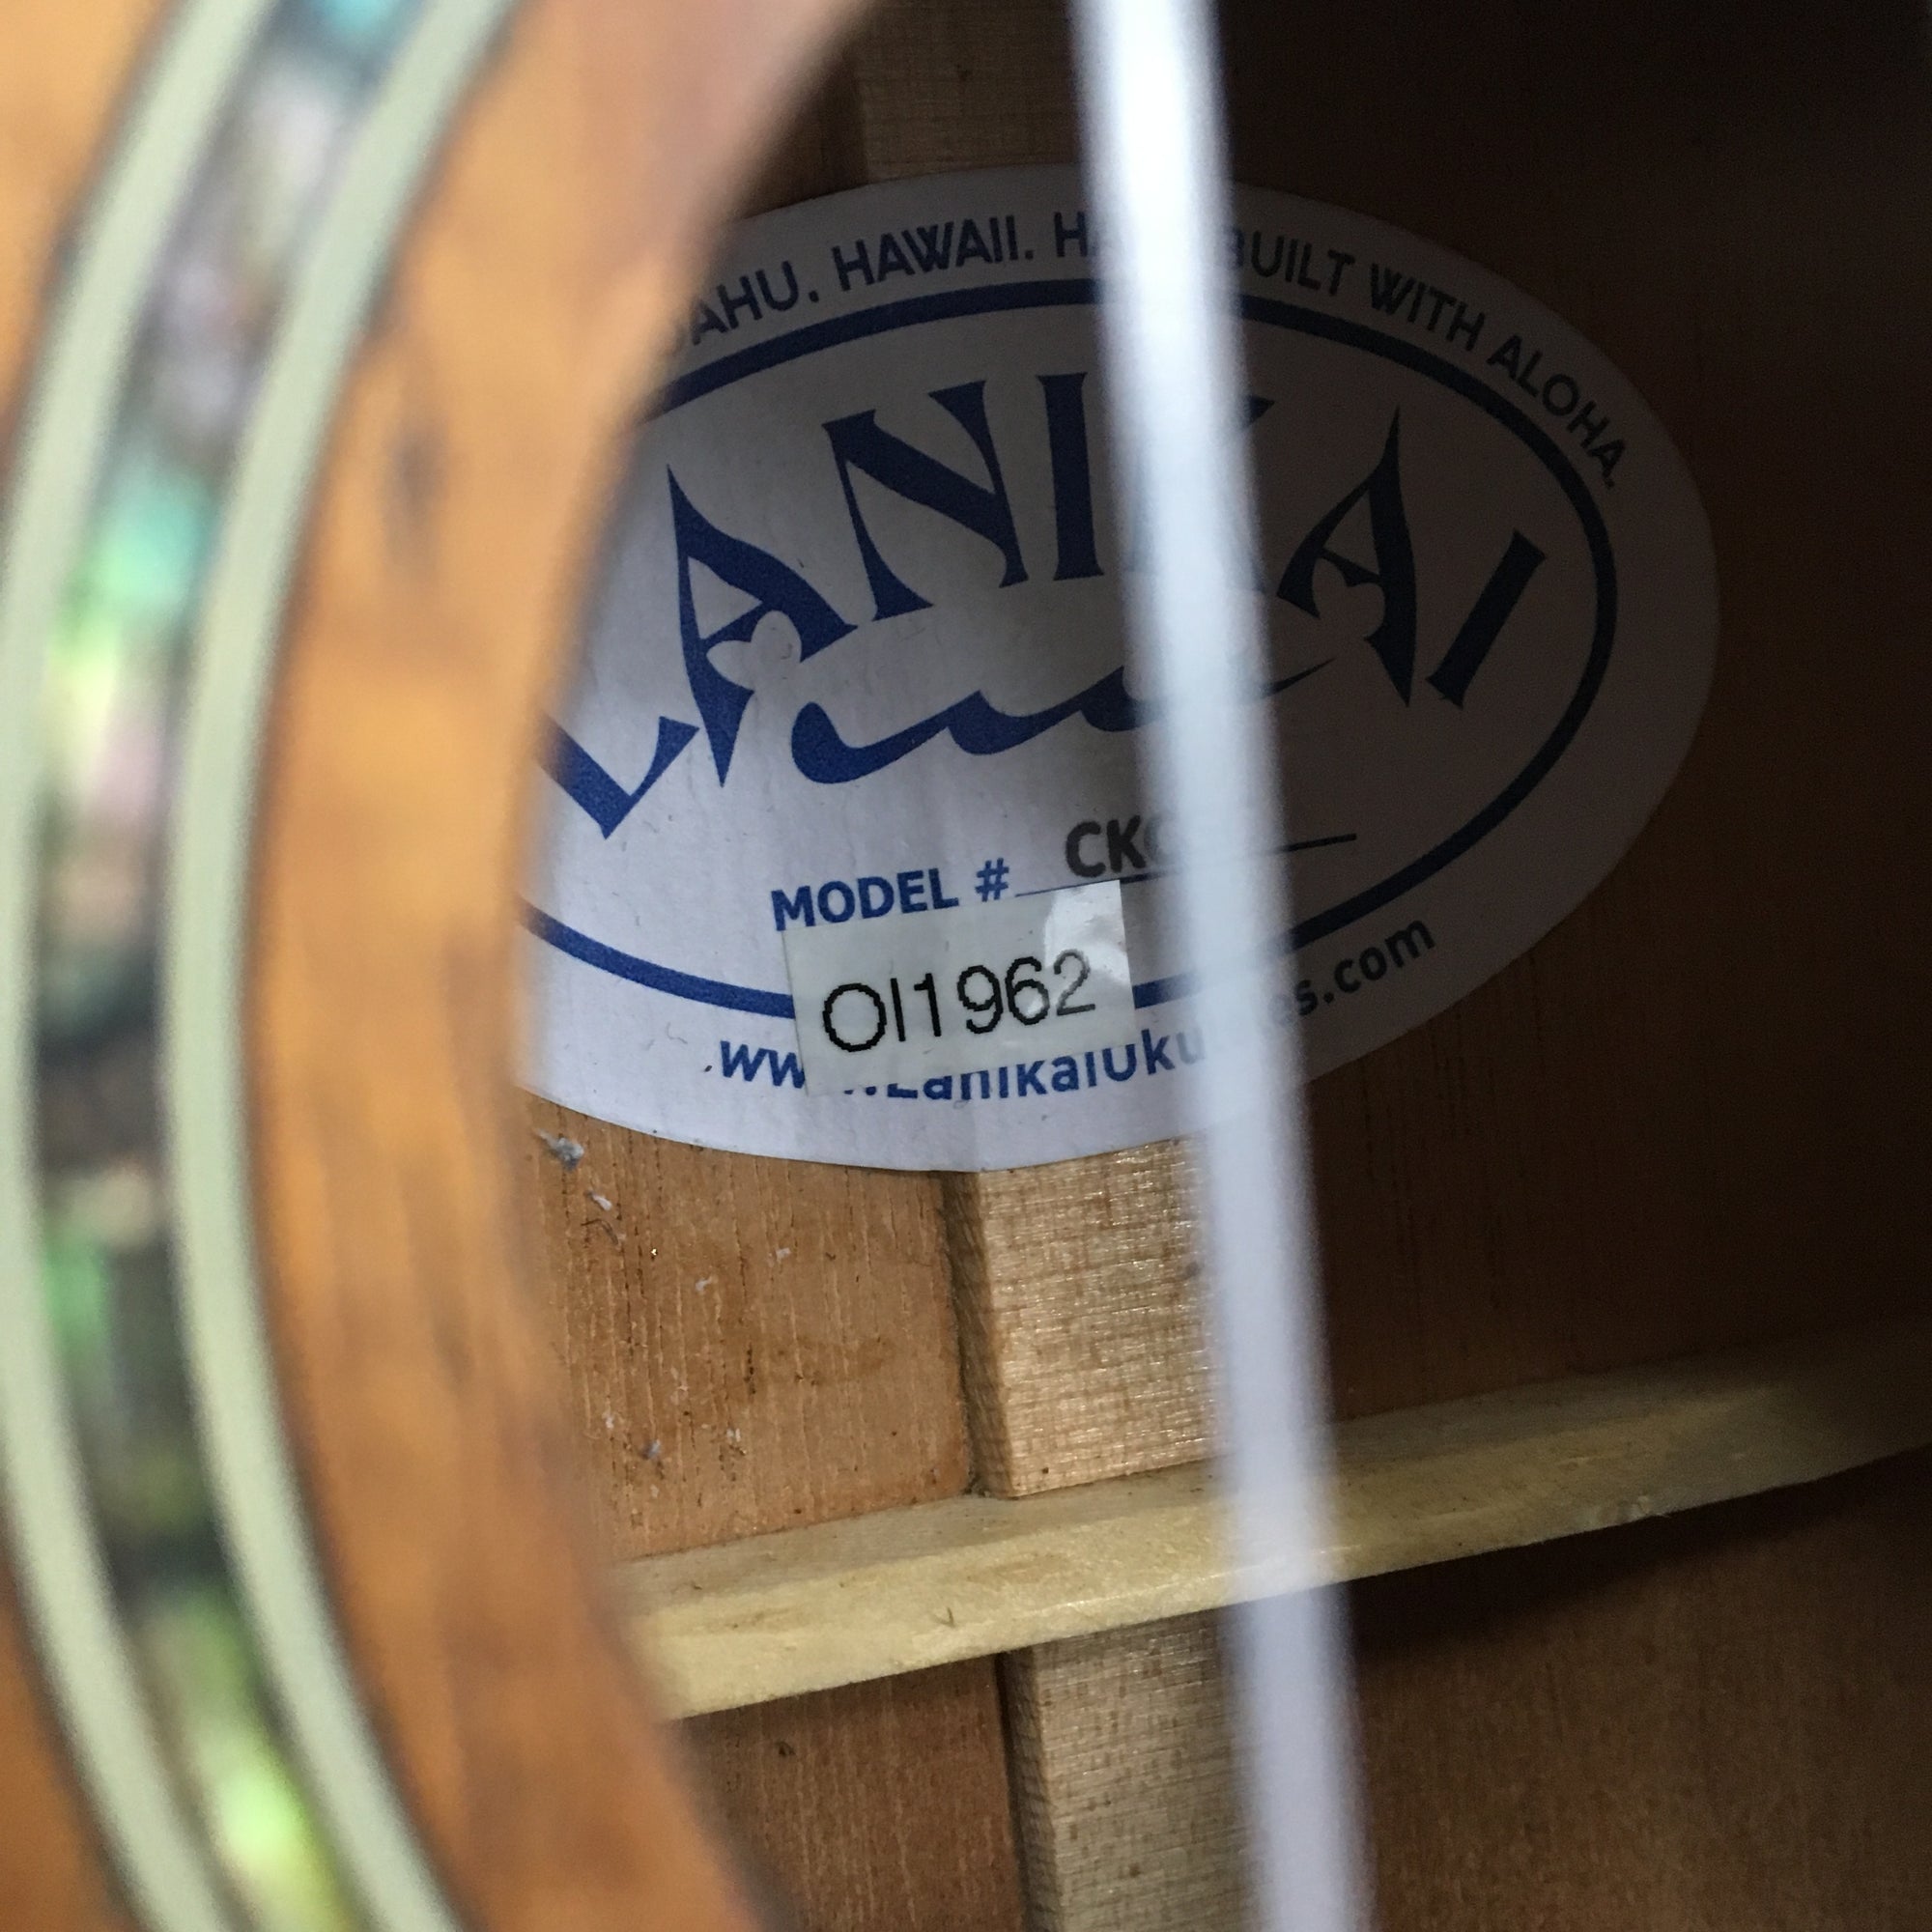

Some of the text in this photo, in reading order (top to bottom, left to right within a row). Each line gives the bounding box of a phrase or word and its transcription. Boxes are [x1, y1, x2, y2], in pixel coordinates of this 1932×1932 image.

[832, 213, 1035, 292] HAWAII.
[1369, 262, 1488, 353] WITH
[1486, 333, 1628, 490] ALOHA.
[533, 371, 1546, 839] LANIAI
[771, 867, 960, 932] MODEL
[975, 858, 1010, 902] #
